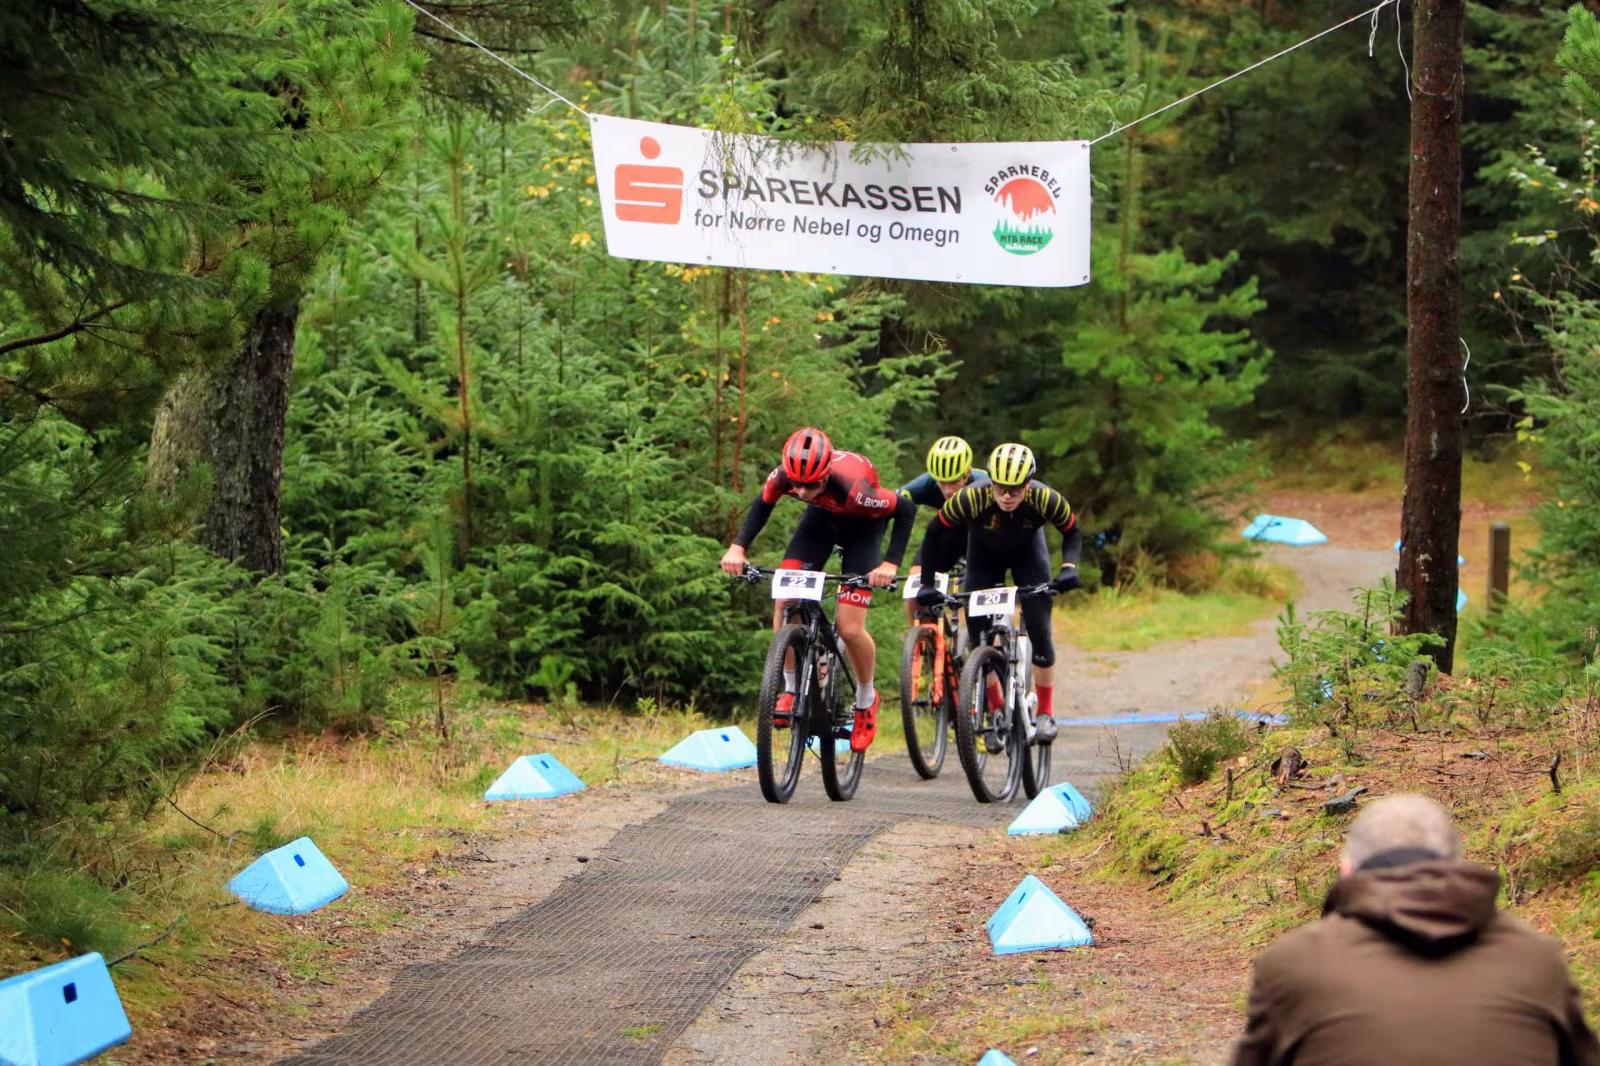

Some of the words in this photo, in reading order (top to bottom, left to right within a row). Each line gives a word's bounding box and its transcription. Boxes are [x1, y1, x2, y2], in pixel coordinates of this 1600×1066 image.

[984, 164, 1061, 198] SPARNEBEL
[697, 169, 962, 214] SPAREKASSEN
[694, 208, 724, 228] for
[730, 211, 786, 232] Nørre
[793, 215, 850, 236] Nebel
[857, 224, 882, 243] og
[889, 221, 960, 247] Omegn
[1000, 234, 1018, 243] MTB
[1020, 236, 1043, 244] RACE
[855, 492, 863, 505] IL
[788, 576, 808, 588] 22
[984, 594, 1001, 605] 20
